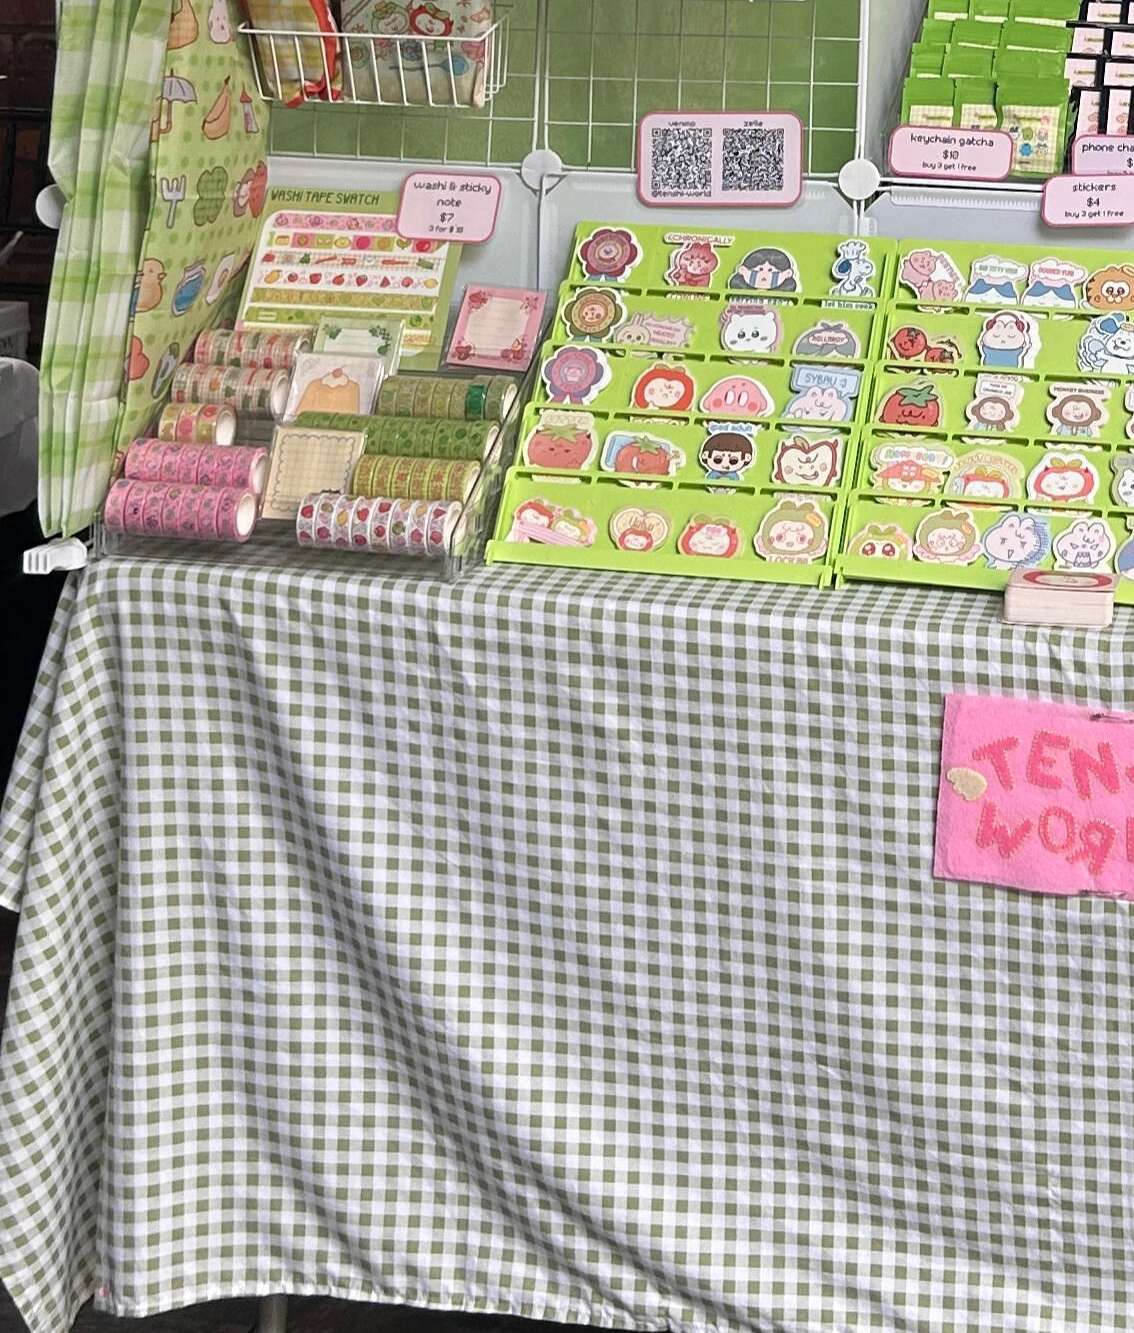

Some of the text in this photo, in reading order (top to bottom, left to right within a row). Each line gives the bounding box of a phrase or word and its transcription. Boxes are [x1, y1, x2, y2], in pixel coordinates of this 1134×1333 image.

[910, 133, 995, 147] keychain gatcha
[1081, 143, 1114, 153] phone
[942, 149, 960, 160] $10
[922, 161, 937, 169] buy
[944, 163, 956, 171] get
[961, 163, 977, 171] free
[413, 180, 492, 195] washi & sticky
[1072, 182, 1117, 192] stickers
[270, 188, 380, 206] WASHI TAPE SWATCH
[436, 197, 463, 208] note
[1086, 196, 1100, 207] $4
[440, 212, 455, 223] $7
[1087, 211, 1101, 219] get
[1106, 210, 1124, 218] free
[804, 373, 838, 386] SYBAU
